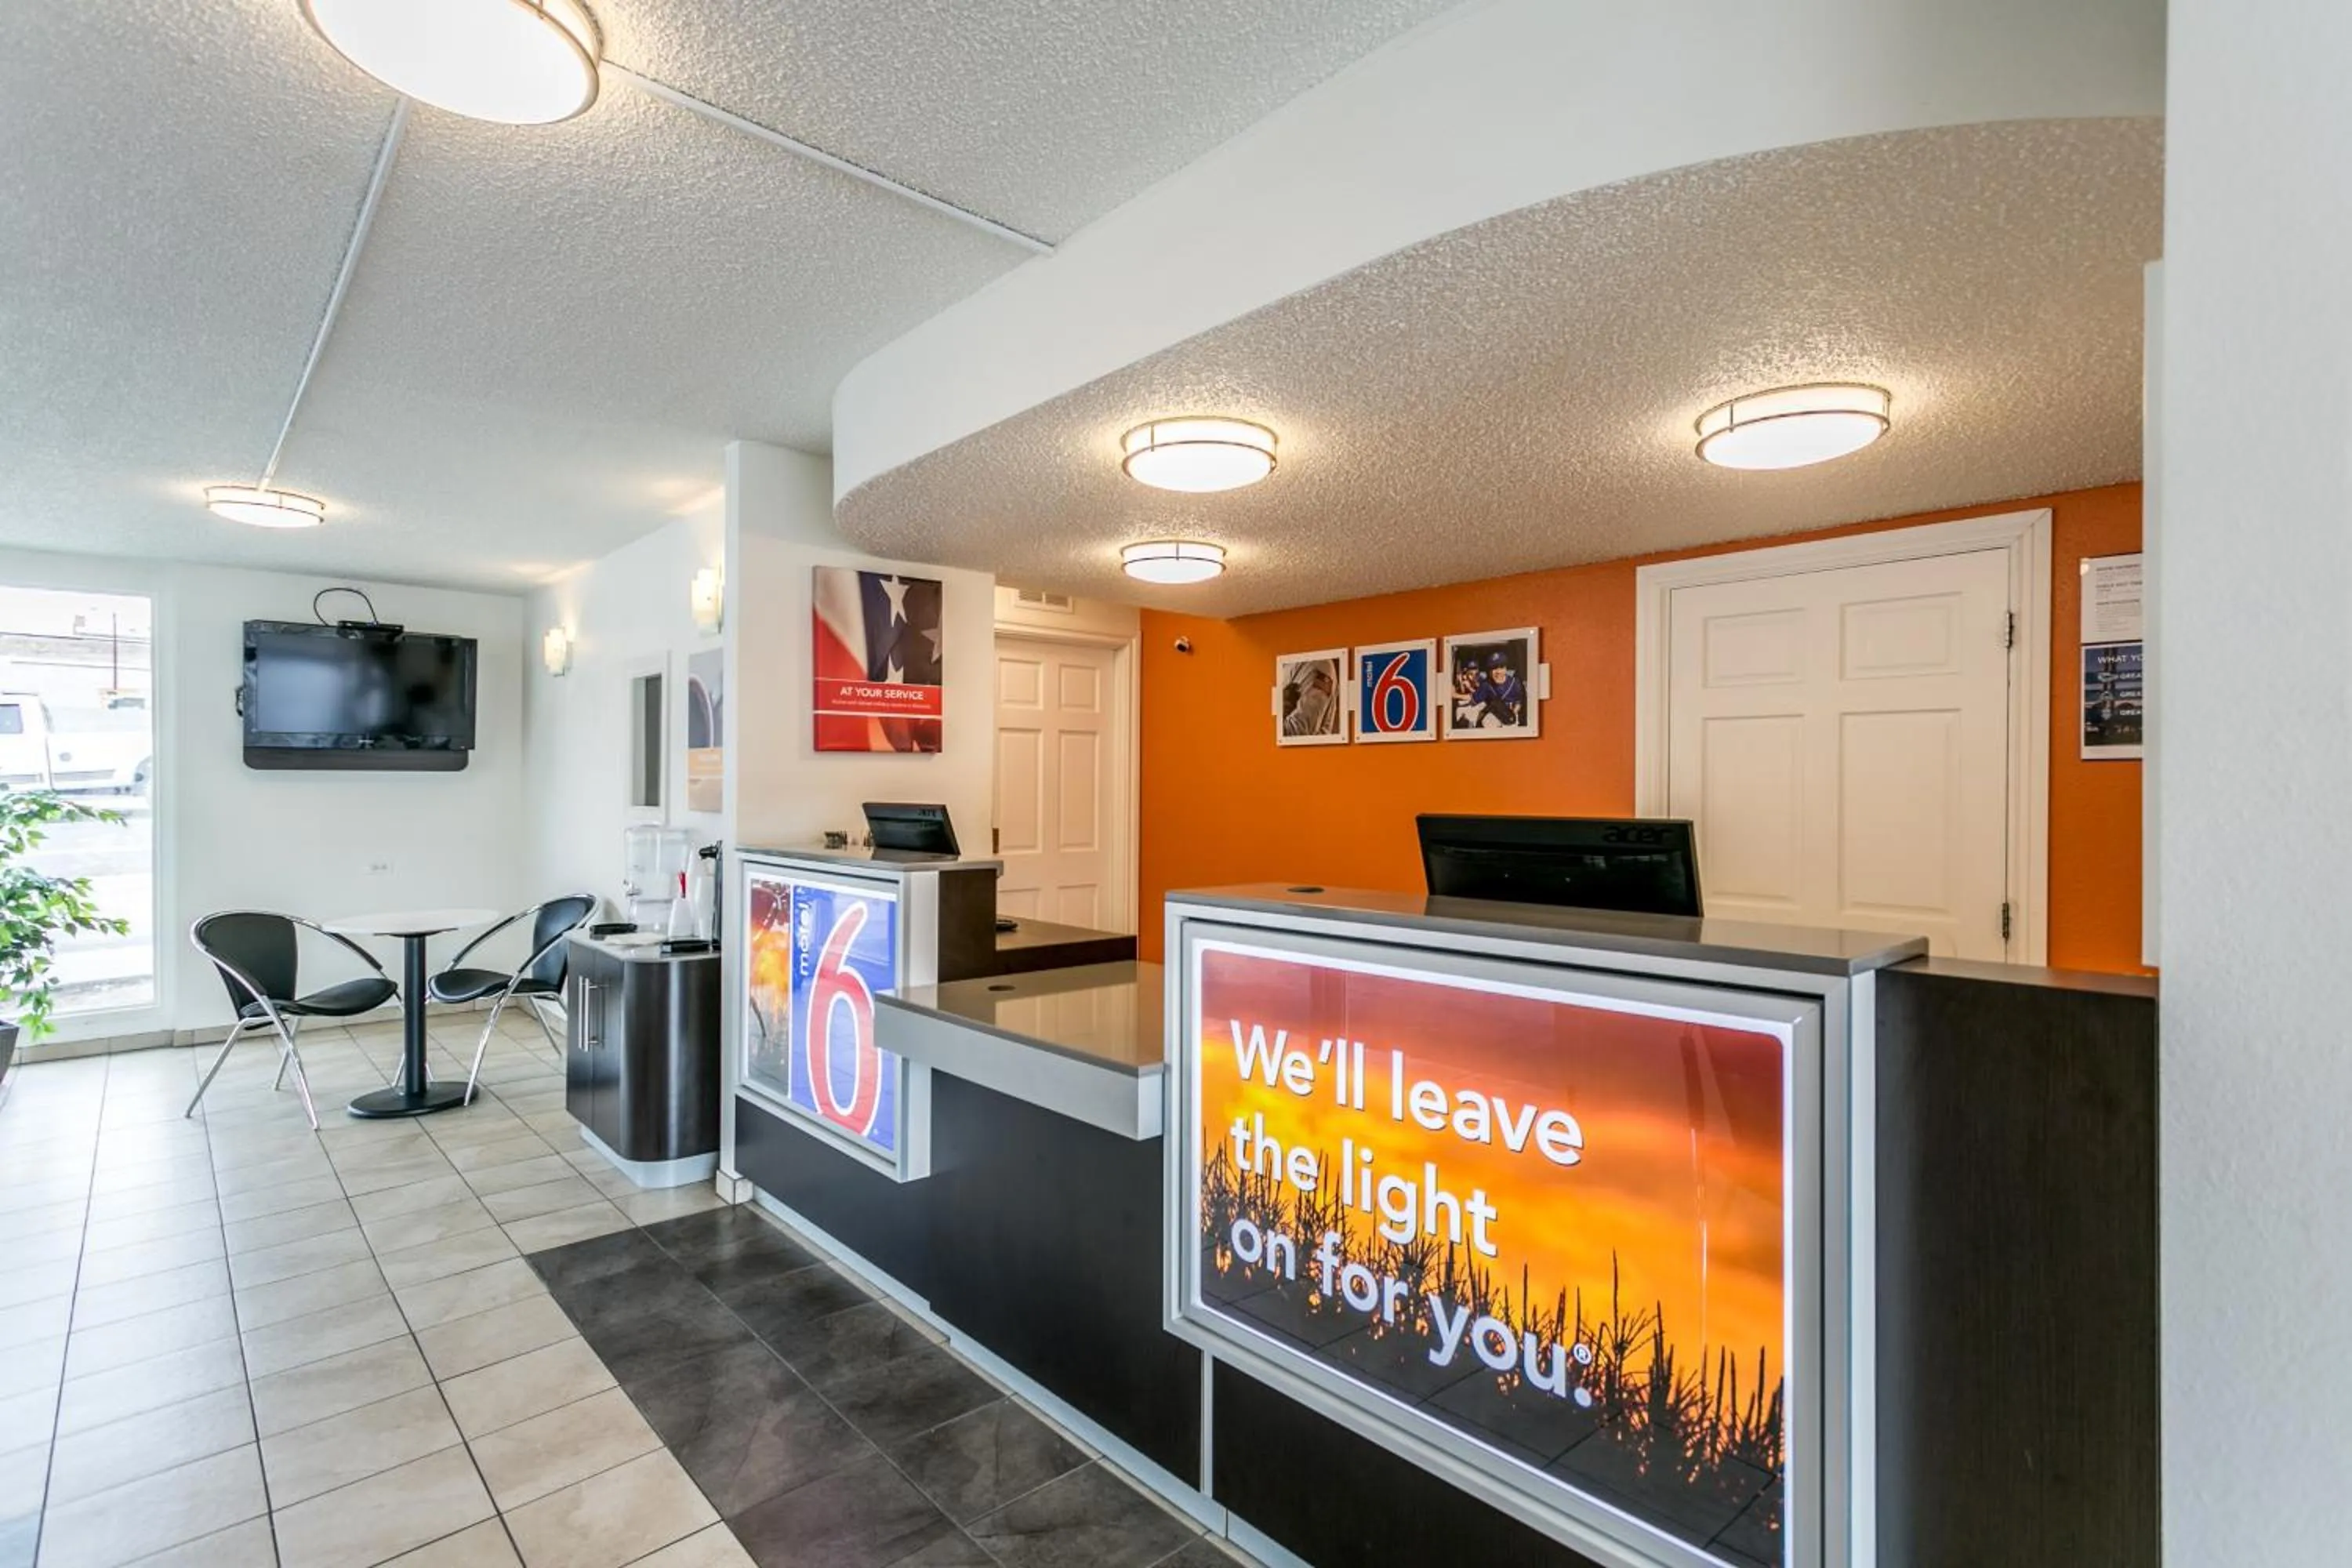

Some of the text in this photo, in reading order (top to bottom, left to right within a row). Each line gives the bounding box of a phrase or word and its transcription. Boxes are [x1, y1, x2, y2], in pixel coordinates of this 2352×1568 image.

[840, 687, 924, 700] AT YOUR SERVICE
[1372, 652, 1419, 732] 6
[2097, 654, 2143, 664] WHAT YO
[1602, 826, 1673, 844] acer
[798, 902, 811, 976] motel
[807, 902, 881, 1135] 6
[1392, 1049, 1584, 1166] leave
[1230, 1112, 1498, 1258] the light
[1230, 1218, 1296, 1279] on
[1317, 1230, 1409, 1324] for
